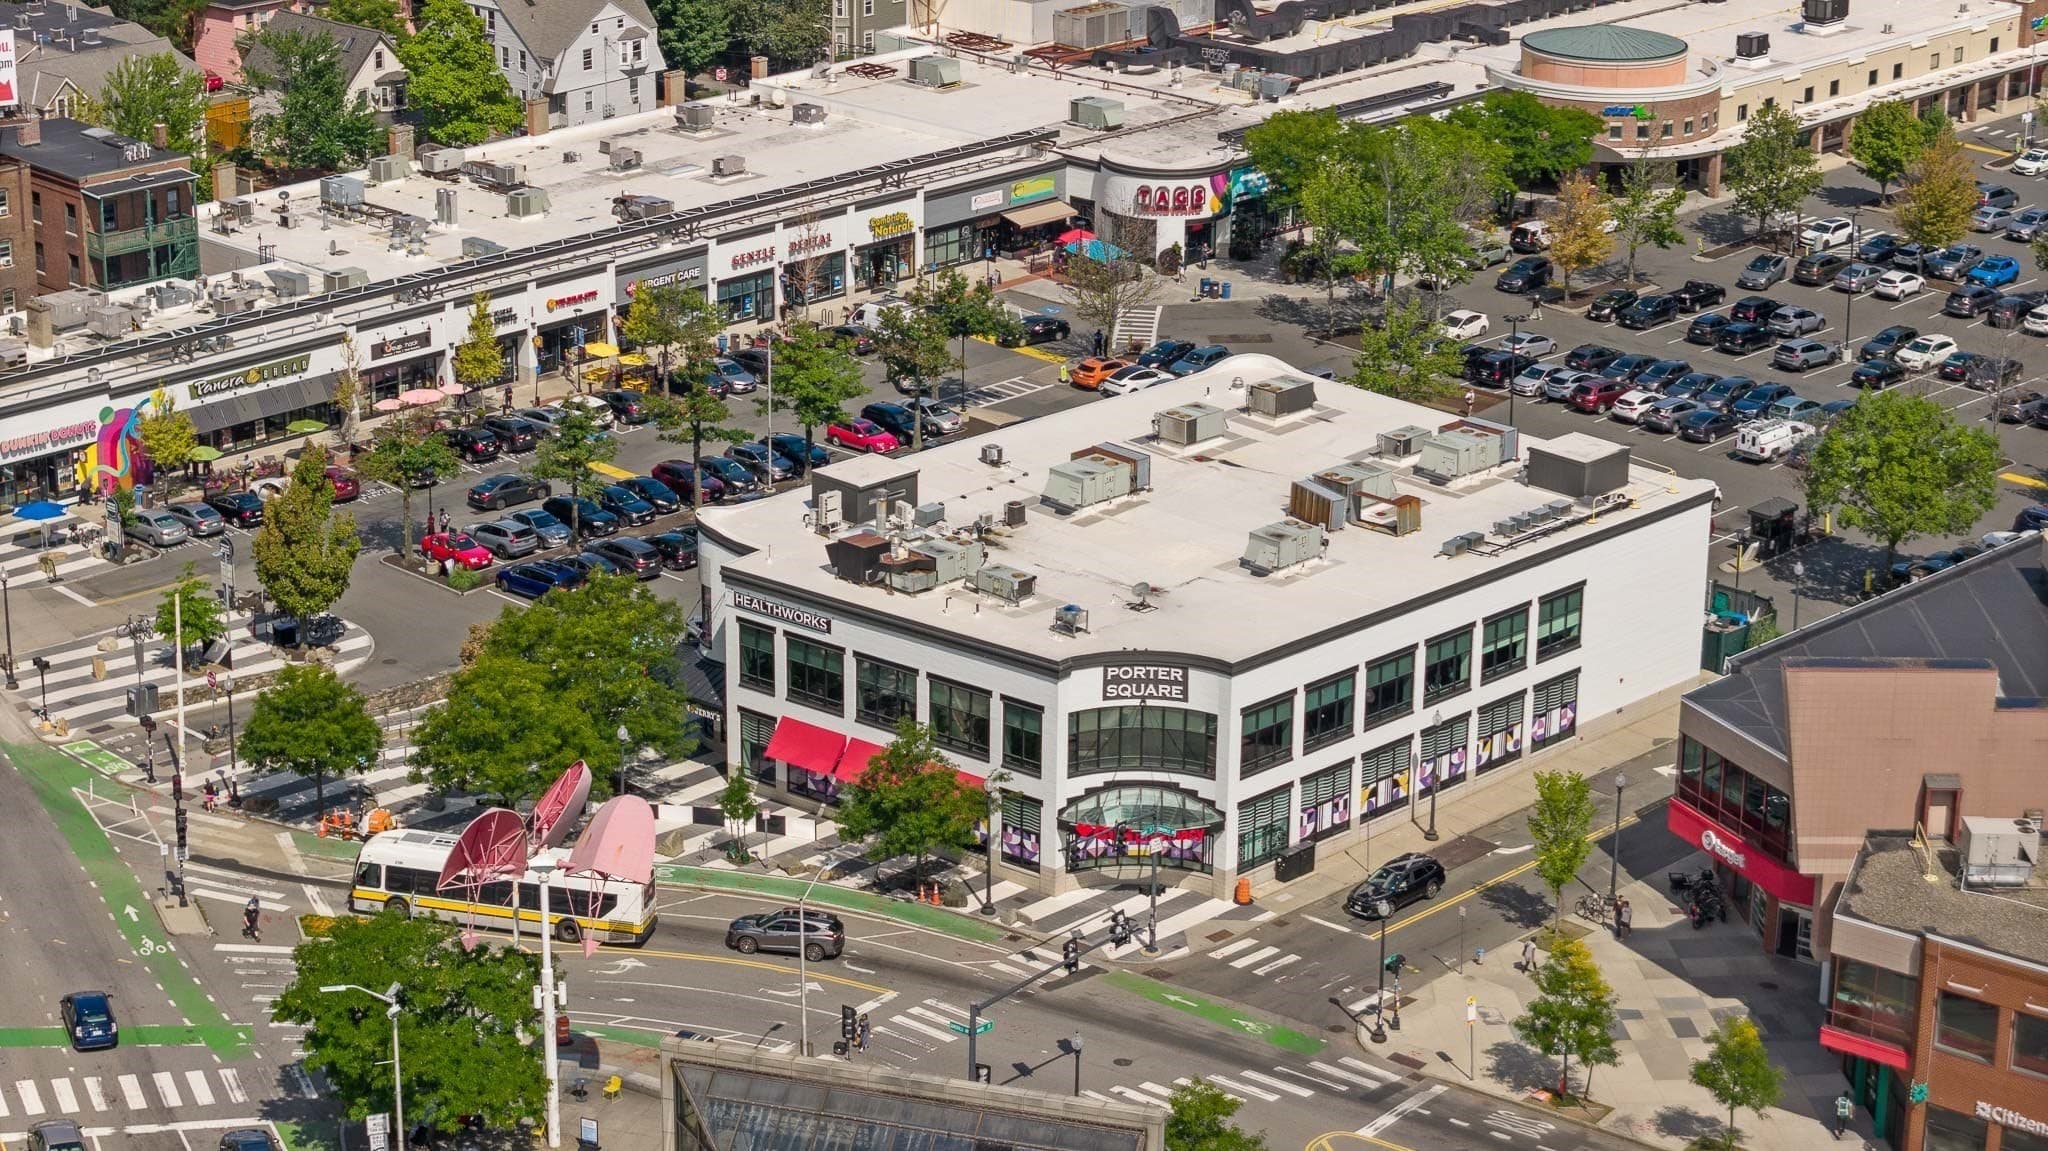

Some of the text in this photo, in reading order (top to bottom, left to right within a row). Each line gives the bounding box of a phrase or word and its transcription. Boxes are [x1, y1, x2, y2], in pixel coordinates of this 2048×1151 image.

[0, 42, 12, 53] u.
[1138, 186, 1205, 206] TAGS
[732, 232, 832, 265] GENTLE DENTAL
[640, 273, 677, 289] URGENT
[677, 267, 701, 281] CARE
[194, 360, 308, 396] Panera BREAD
[50, 420, 97, 442] DONUTS
[735, 592, 828, 630] HEALTHWORKS
[1106, 666, 1184, 682] PORTER
[1106, 683, 1184, 699] SQUARE
[1714, 838, 1746, 869] target
